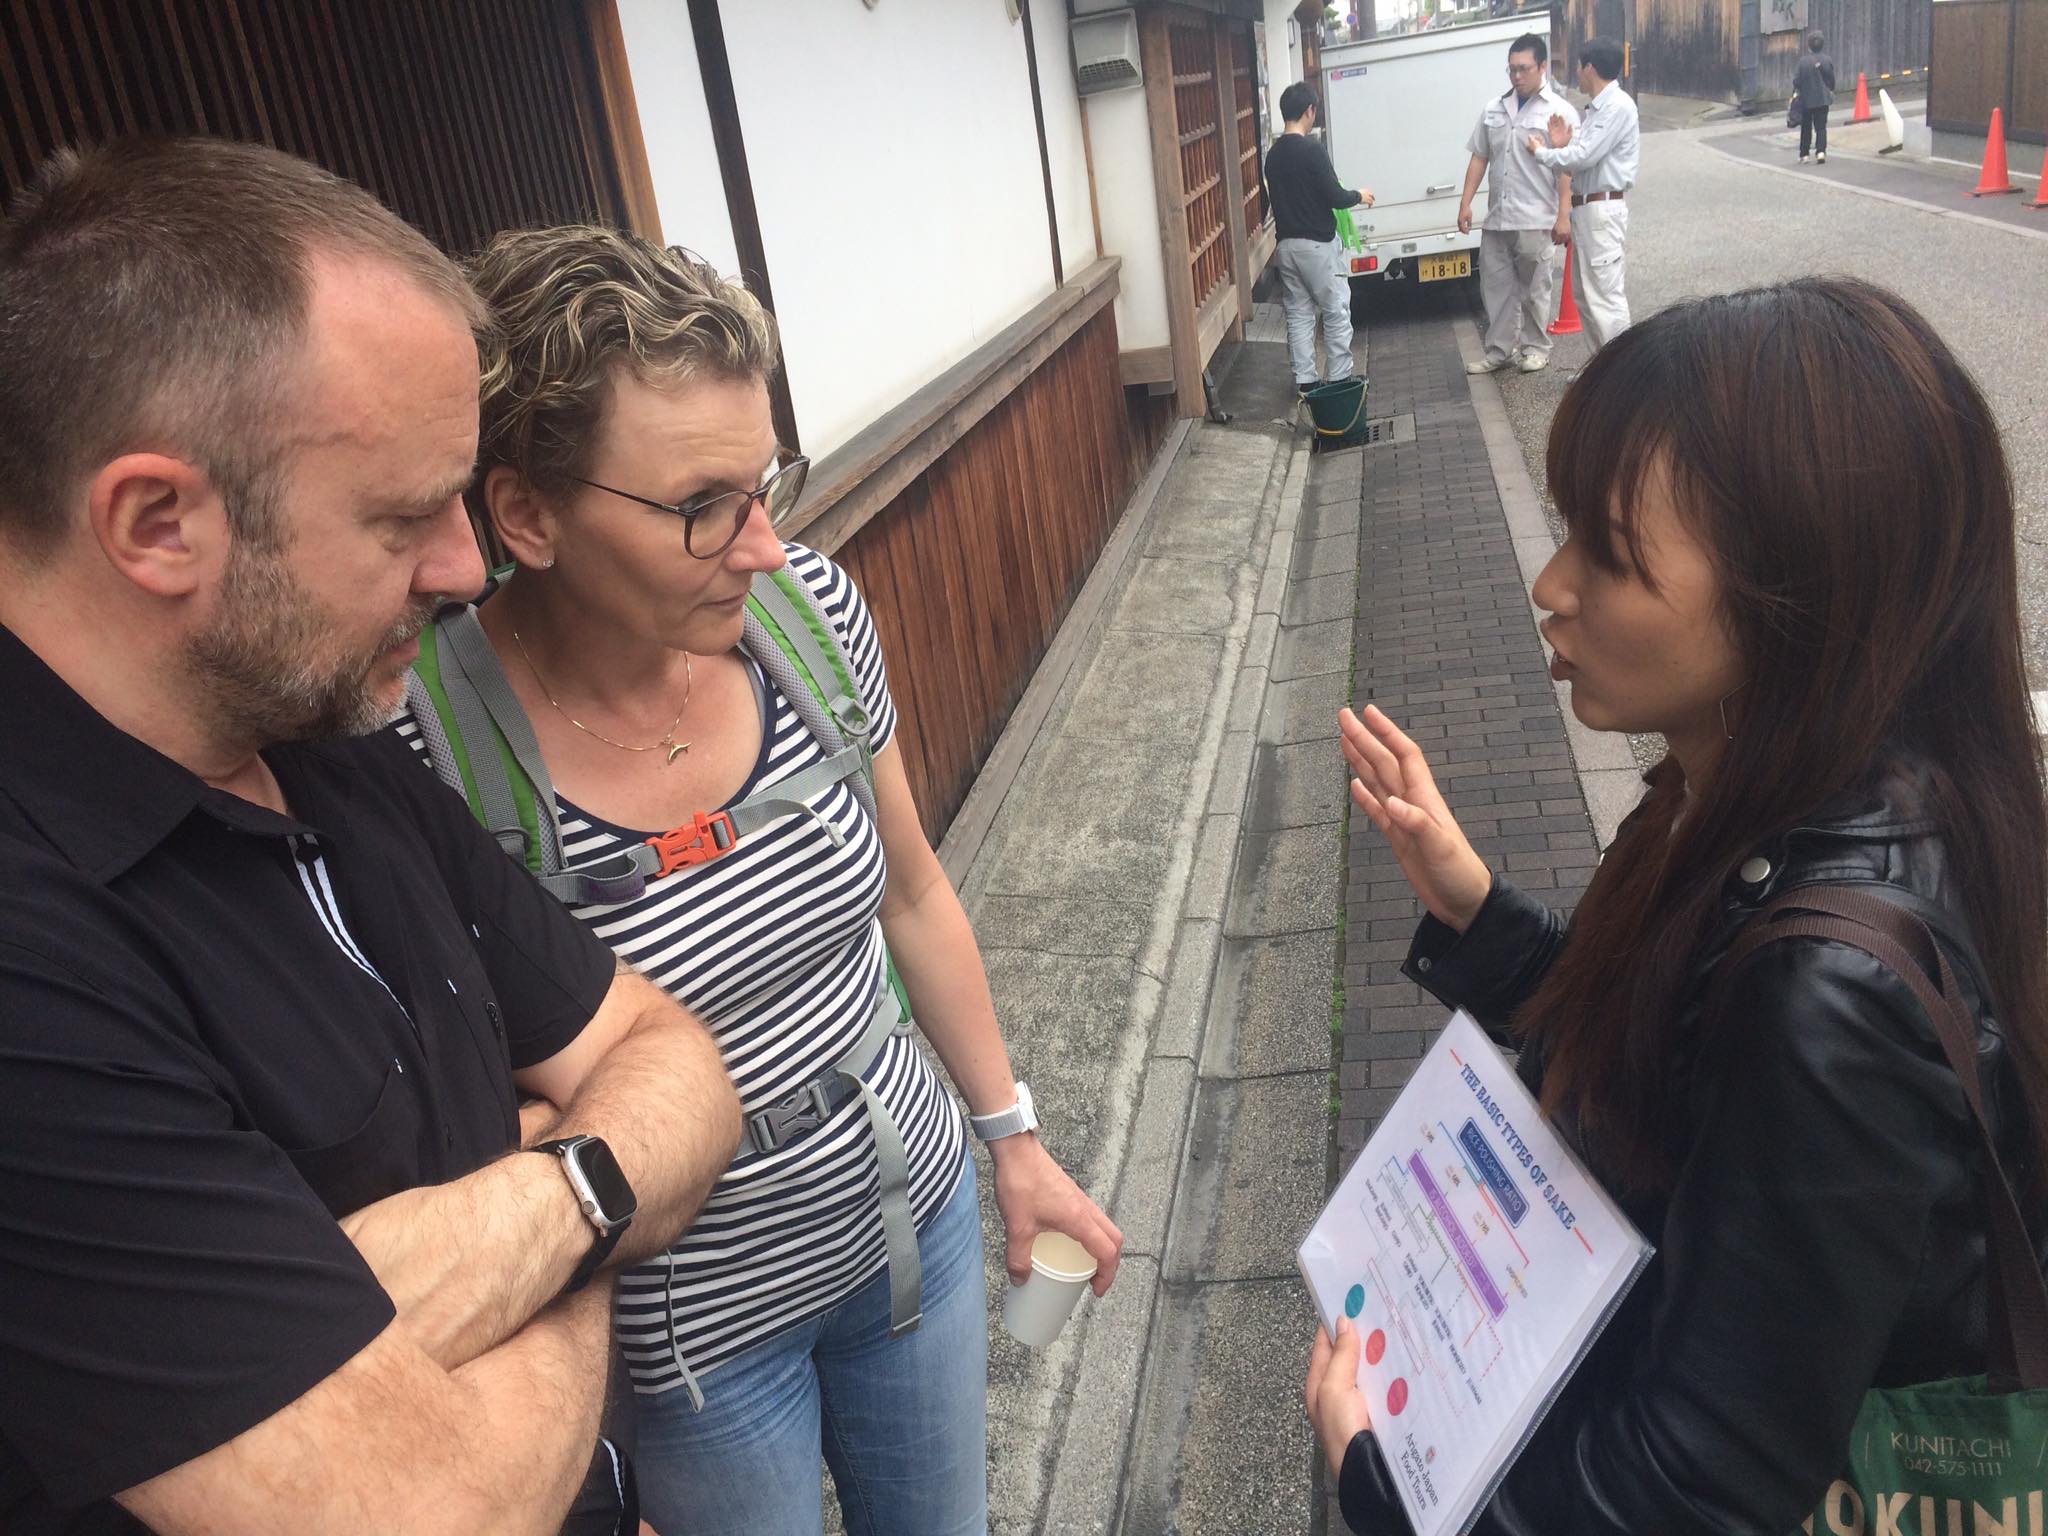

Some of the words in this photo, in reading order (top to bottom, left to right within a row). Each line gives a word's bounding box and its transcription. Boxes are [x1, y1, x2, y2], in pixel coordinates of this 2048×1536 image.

[1432, 261, 1467, 278] 18-18
[1460, 1063, 1481, 1092] THE
[1477, 1086, 1504, 1128] BASIC
[1500, 1122, 1533, 1169] TYPES
[1528, 1161, 1547, 1189] OF
[1541, 1181, 1577, 1231] SAKE
[1502, 1182, 1522, 1212] RATIO
[1404, 1432, 1425, 1473] Arigato
[1422, 1469, 1439, 1507] Japan
[1890, 1432, 2011, 1458] KUNITACHI
[1400, 1449, 1416, 1480] Food
[1412, 1474, 1427, 1511] Tours
[1801, 1479, 2043, 1536] OKUNI
